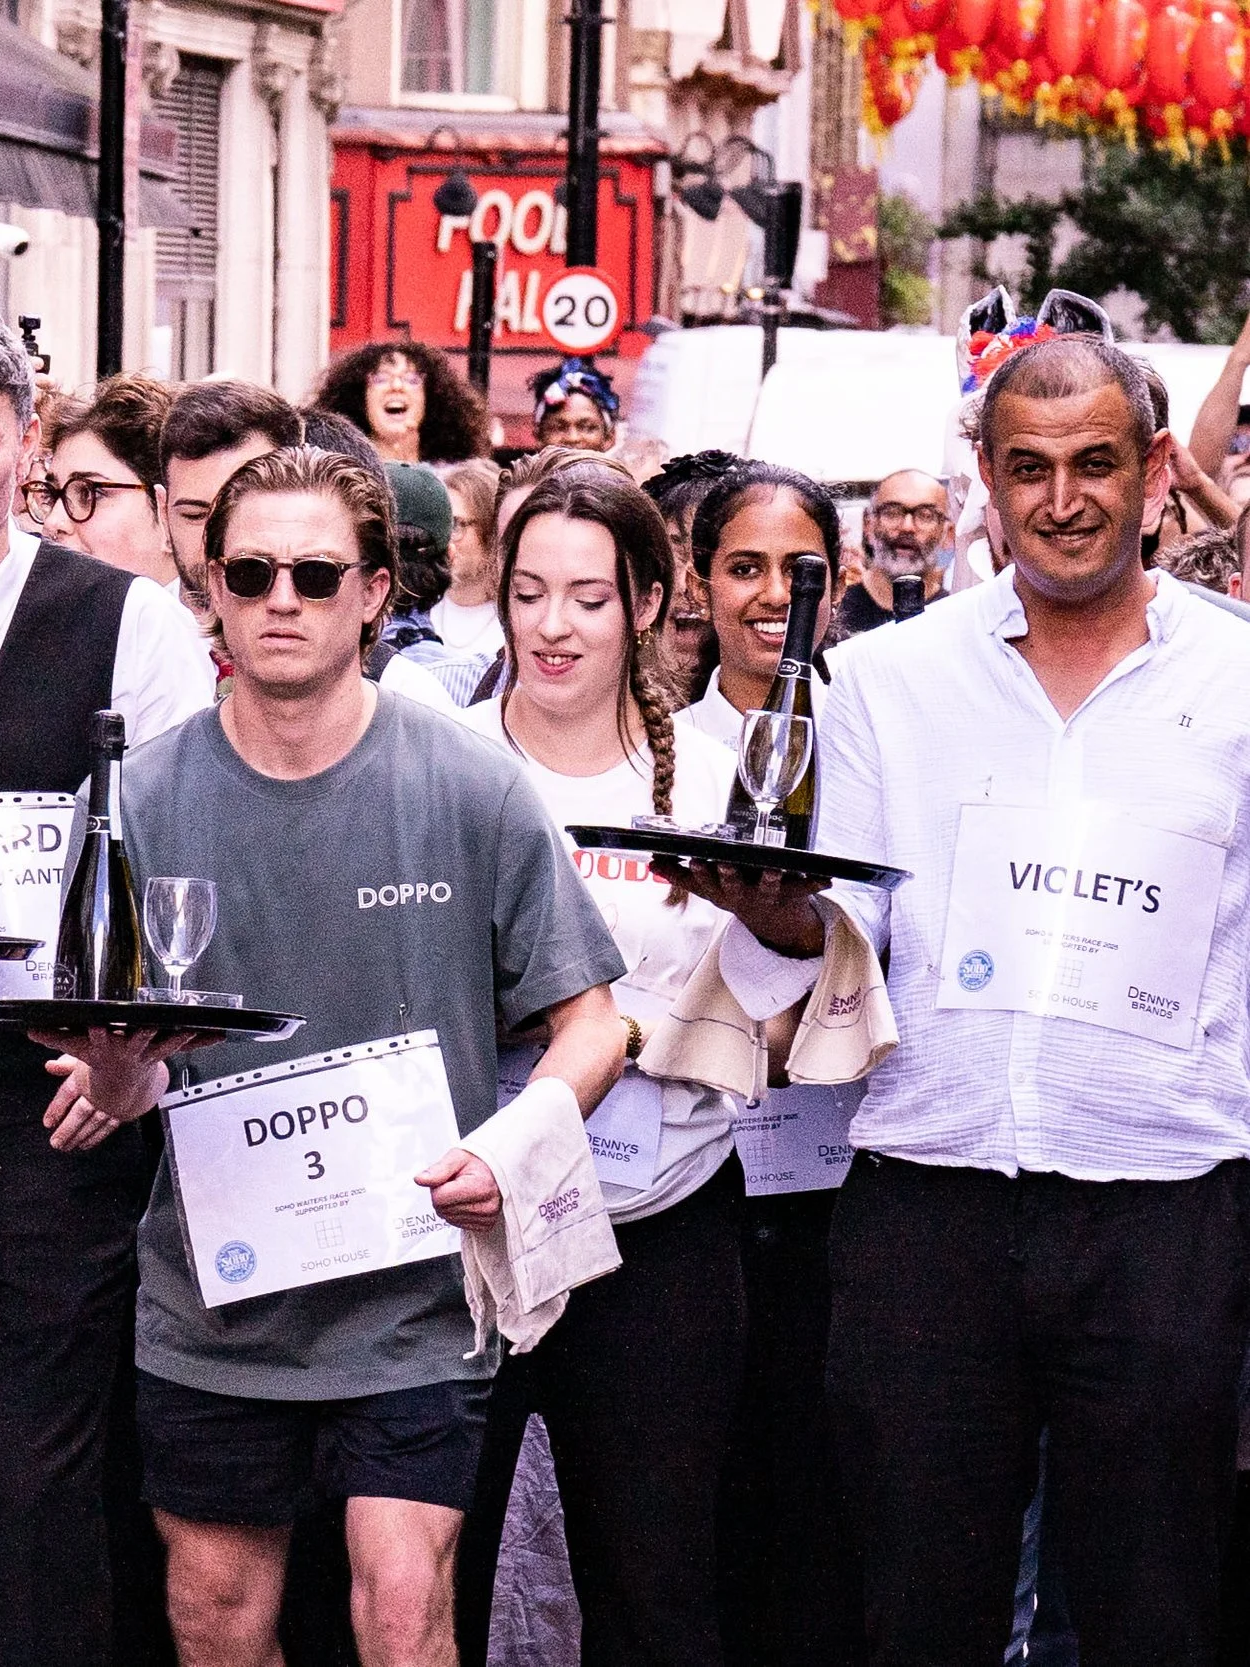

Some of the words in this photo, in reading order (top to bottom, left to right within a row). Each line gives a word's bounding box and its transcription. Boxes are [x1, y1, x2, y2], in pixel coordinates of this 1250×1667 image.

[554, 296, 609, 328] 20
[357, 882, 452, 909] DOPPO
[1010, 862, 1162, 914] VIOLET'S
[1081, 937, 1103, 947] RACE
[1062, 995, 1099, 1011] HOUSE
[1127, 986, 1180, 1012] DENNYS
[1131, 1001, 1174, 1020] BRANDS
[244, 1095, 369, 1147] DOPPO
[763, 1114, 782, 1122] RACE
[304, 1151, 325, 1180] 3
[589, 1147, 631, 1163] RANDS
[761, 1171, 797, 1182] HOUSE
[275, 1203, 295, 1213] SOHO
[296, 1196, 329, 1208] WAITERS
[330, 1191, 349, 1201] RACE
[294, 1203, 339, 1217] SUPPORTED
[340, 1200, 350, 1208] BY
[539, 1187, 580, 1218] DENNYS
[546, 1200, 579, 1224] BRANDS
[301, 1258, 331, 1272] SOHO
[333, 1249, 370, 1264] HOUSE
